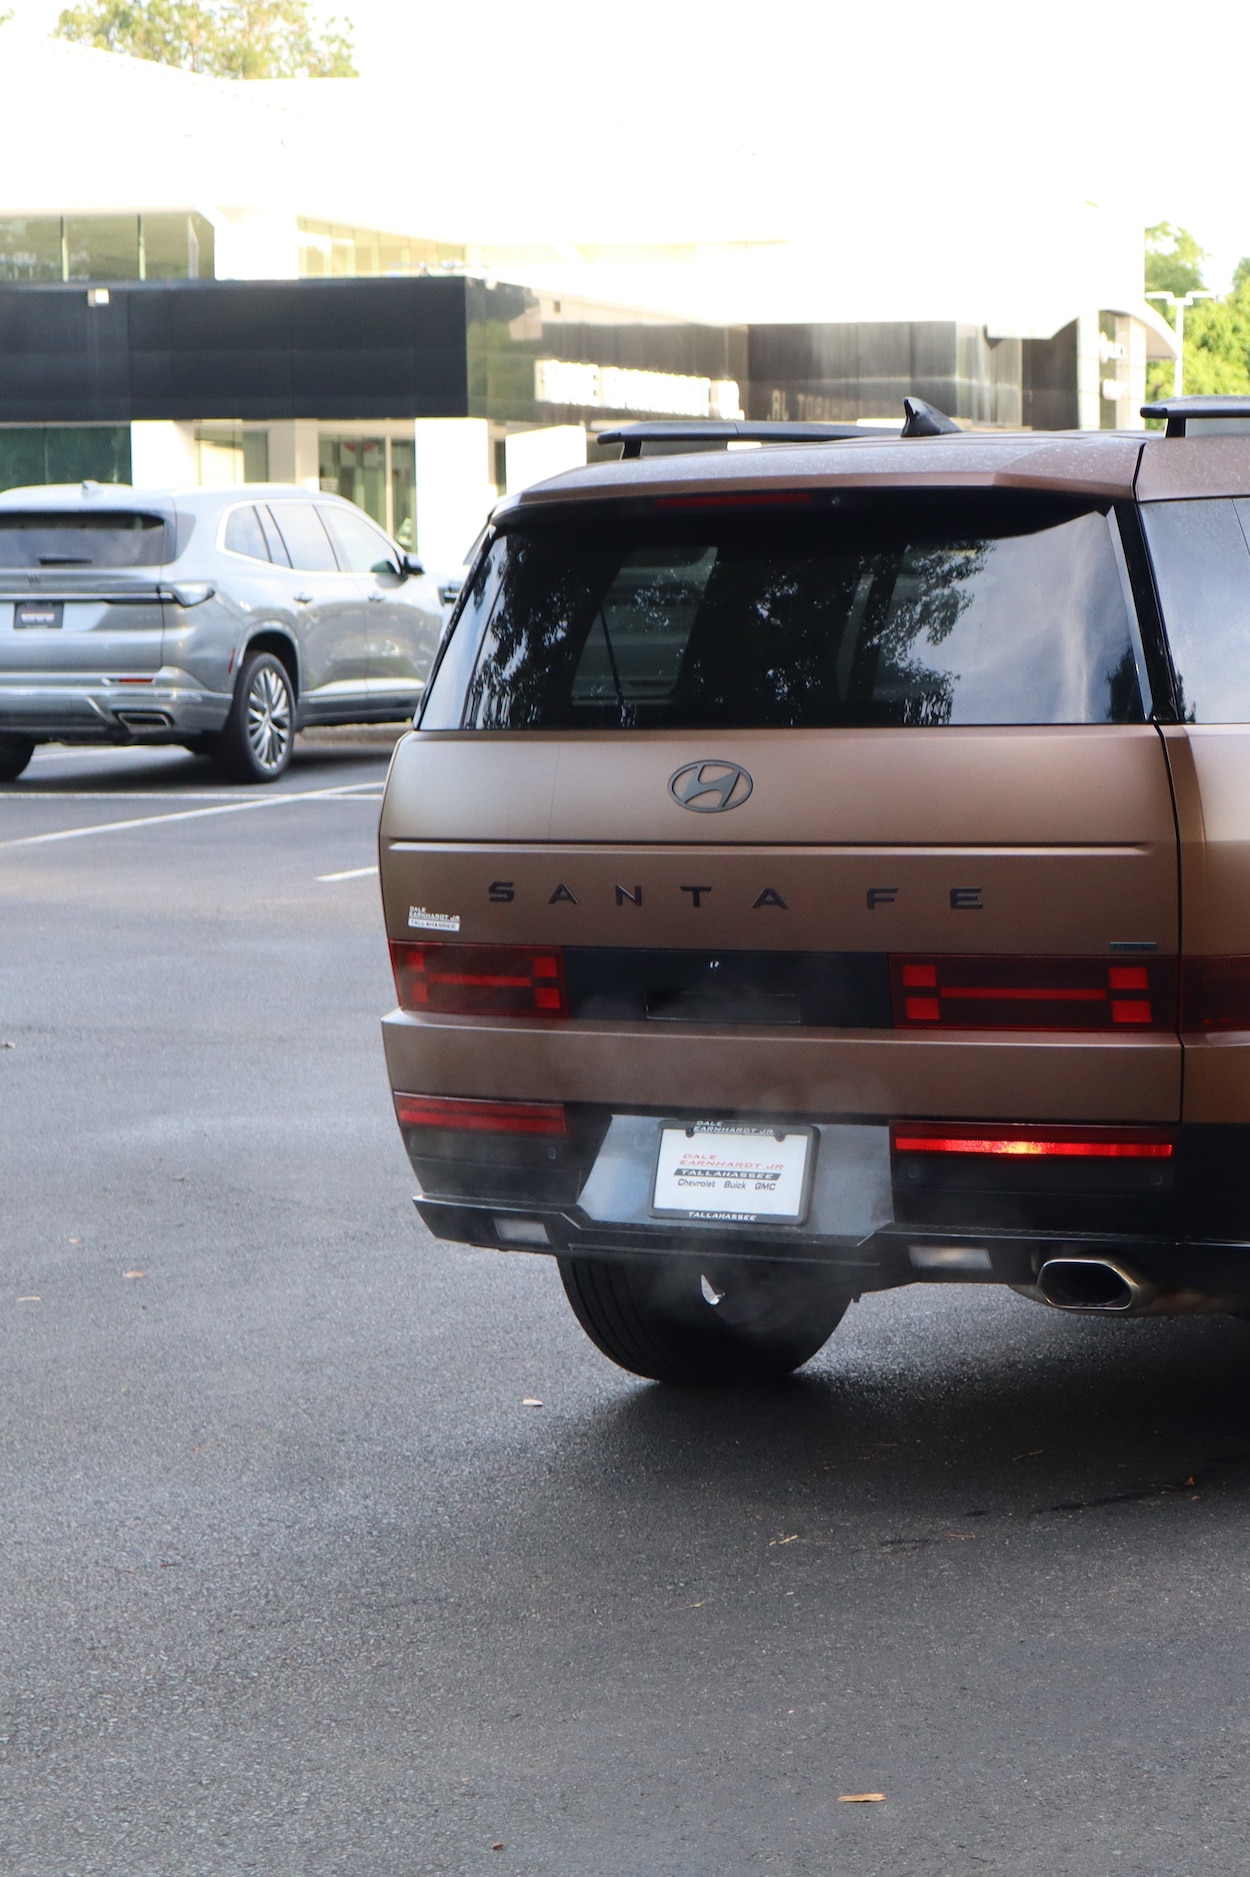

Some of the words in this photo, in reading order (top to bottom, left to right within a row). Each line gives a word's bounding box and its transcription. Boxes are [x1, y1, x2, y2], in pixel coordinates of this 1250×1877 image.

[488, 879, 788, 910] SANTA
[866, 886, 984, 910] FE
[693, 1126, 757, 1134] EARNHARDT
[679, 1160, 762, 1169] EARNHARDT
[680, 1169, 775, 1180] TALLAHASSEE
[677, 1178, 716, 1188] Chevrolet
[724, 1181, 746, 1190] Buick
[755, 1182, 776, 1191] GMC
[688, 1211, 757, 1221] TALLAHASSEE
